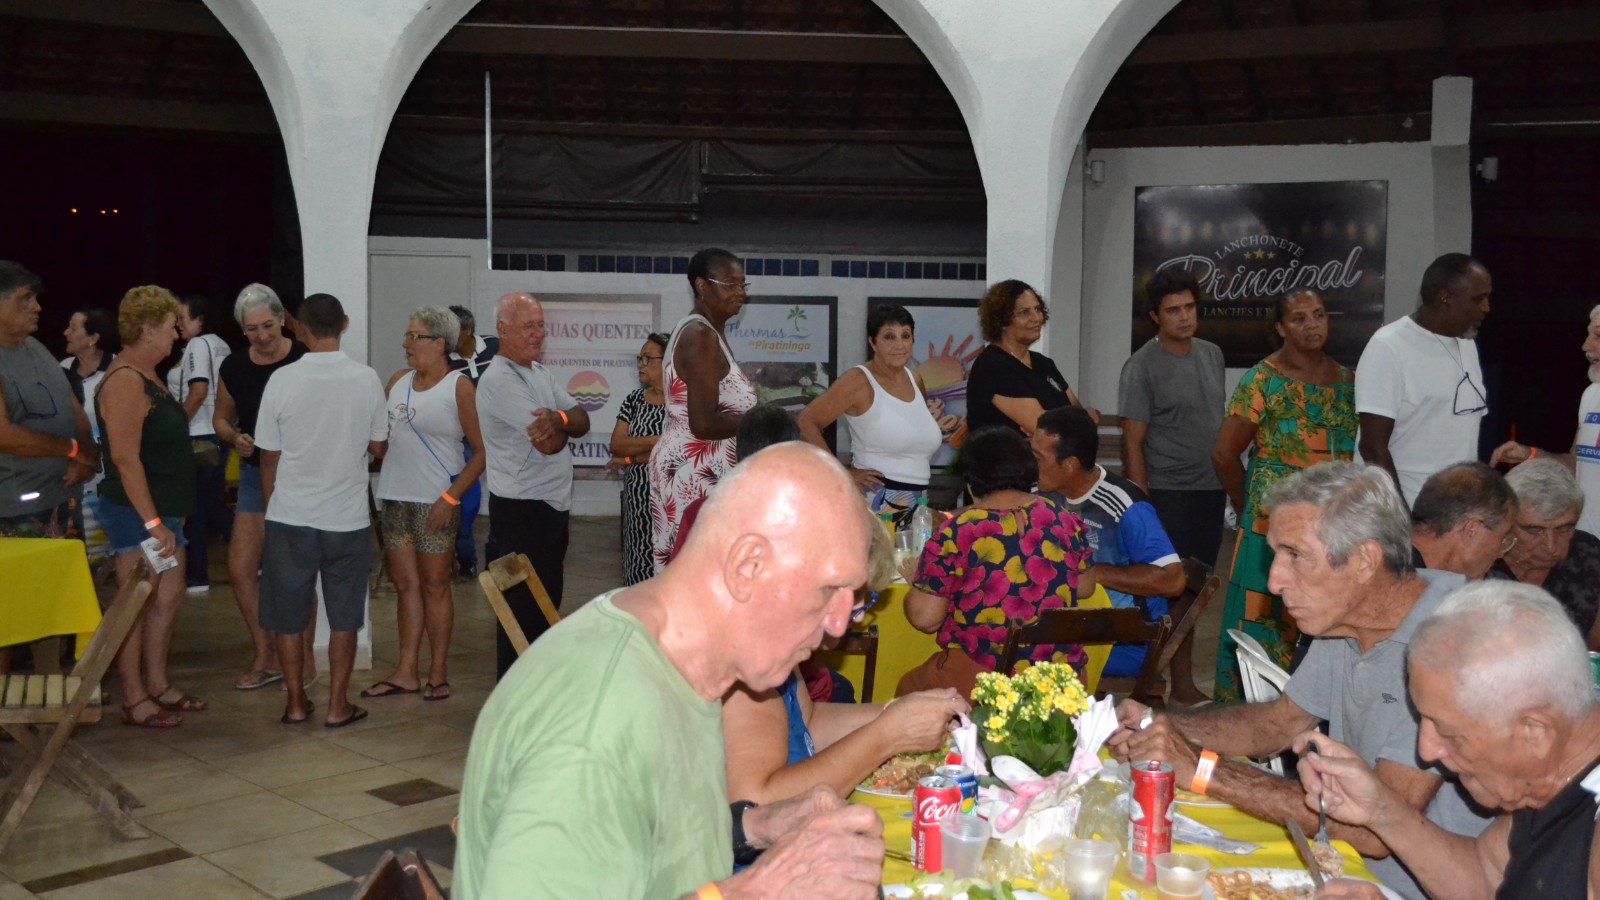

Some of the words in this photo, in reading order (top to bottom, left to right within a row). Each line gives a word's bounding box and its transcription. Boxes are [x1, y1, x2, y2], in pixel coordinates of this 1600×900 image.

[1214, 234, 1304, 260] LANCHONETE
[1156, 246, 1364, 302] Principal
[543, 322, 579, 339] GUAS
[582, 323, 652, 342] QUENTES
[725, 320, 787, 339] Thermas
[755, 340, 811, 352] Piratininga
[559, 359, 592, 367] QUENTES
[592, 359, 601, 368] DE
[568, 442, 611, 458] RATIN
